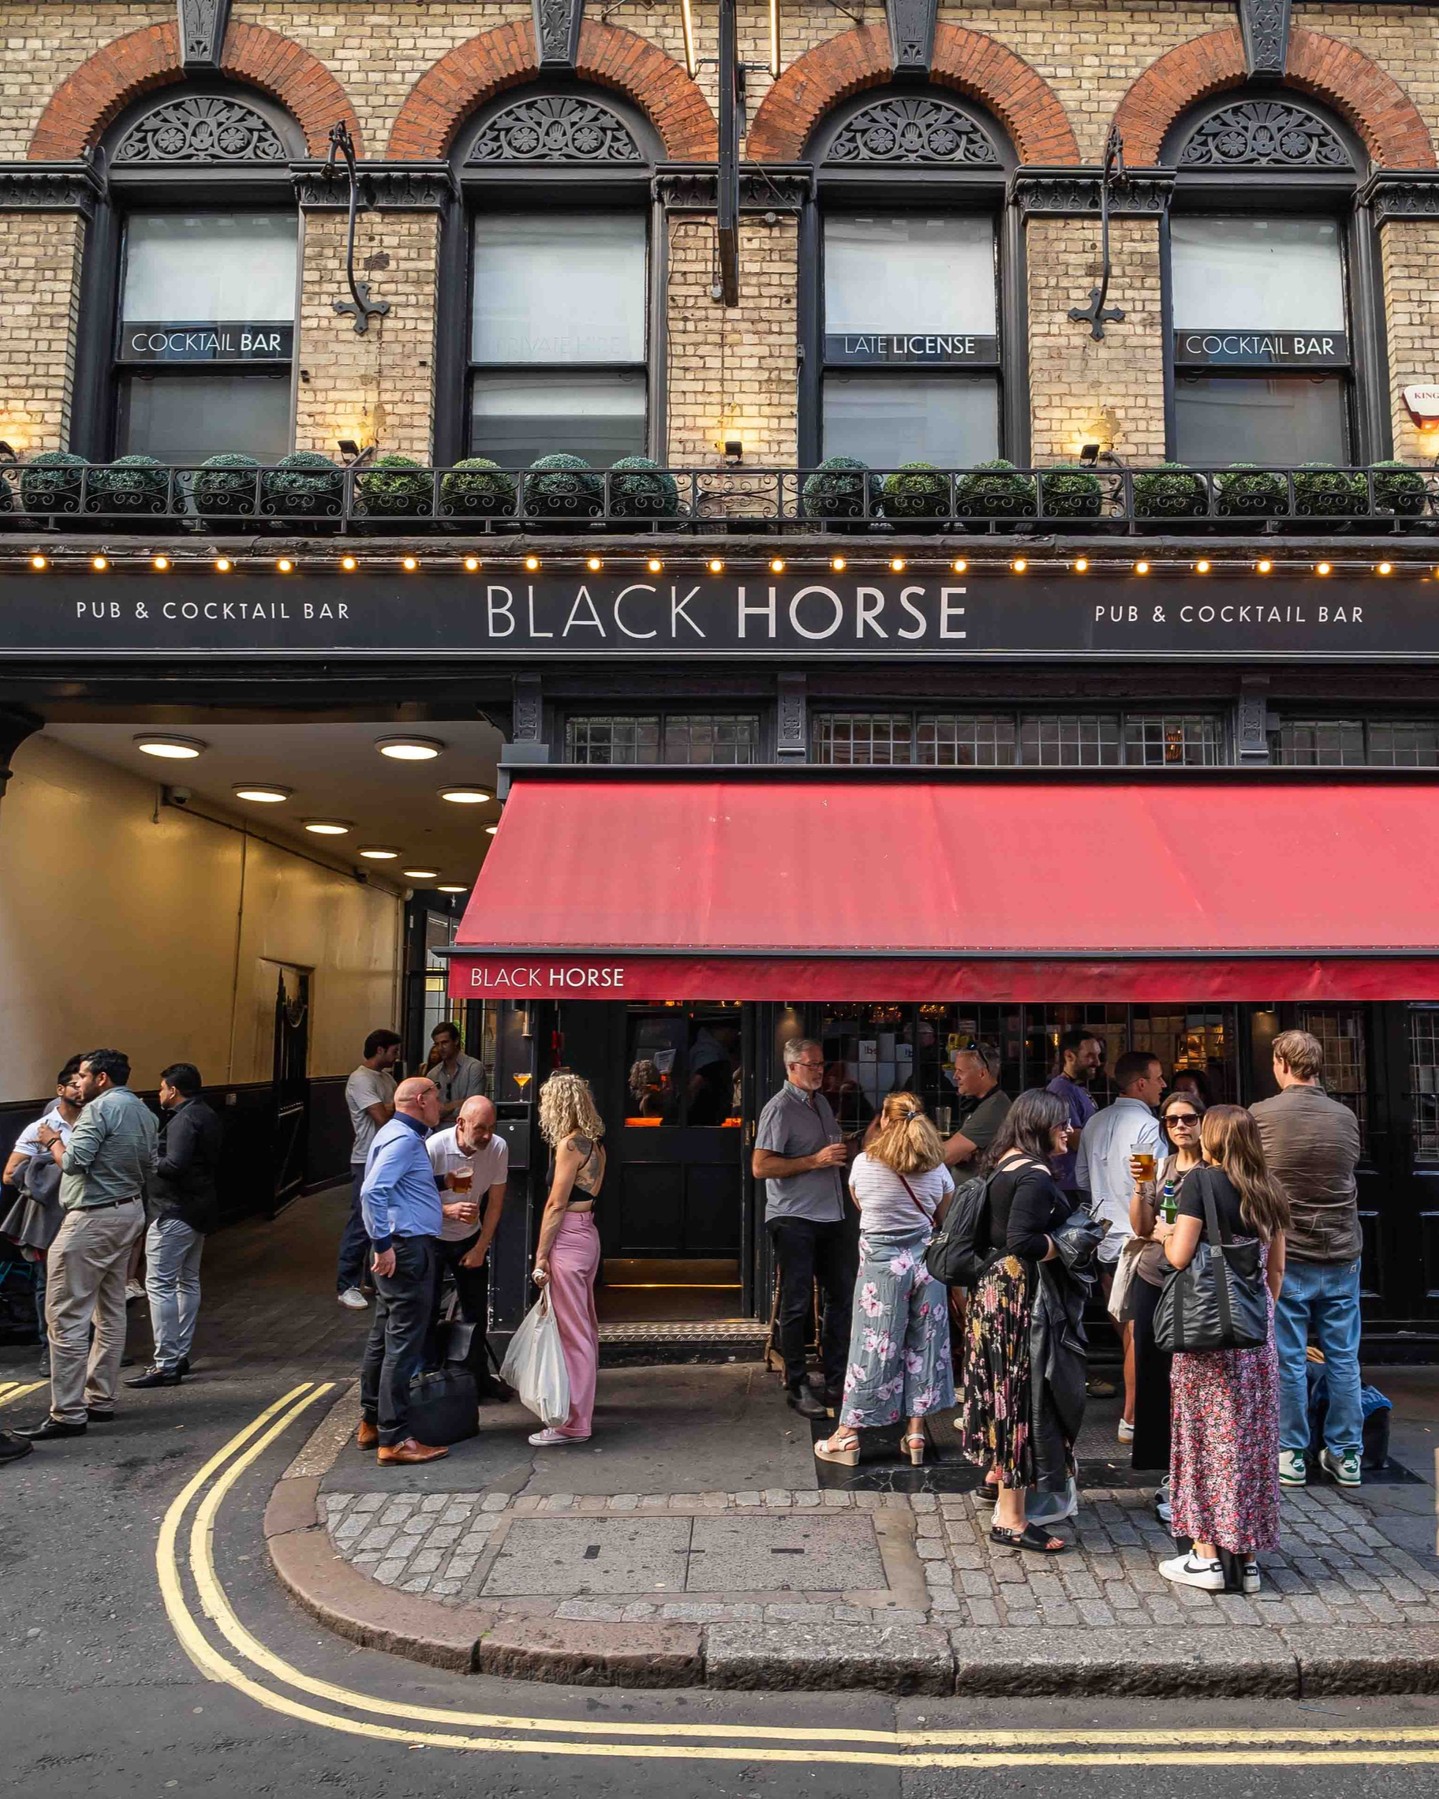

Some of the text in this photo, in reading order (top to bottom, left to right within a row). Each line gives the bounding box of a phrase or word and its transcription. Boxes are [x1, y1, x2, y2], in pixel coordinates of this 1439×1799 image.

[131, 333, 282, 352] COCKTAIL BAR
[844, 335, 976, 355] LATE LICENSE
[1185, 335, 1335, 355] COCKTAIL BAR
[76, 601, 350, 620] PUB & COCKTAIL BAR
[486, 584, 967, 640] BLACK HORSE
[1095, 605, 1363, 624] PUB & COCKTAIL BAR
[470, 967, 625, 988] BLACK HORSE
